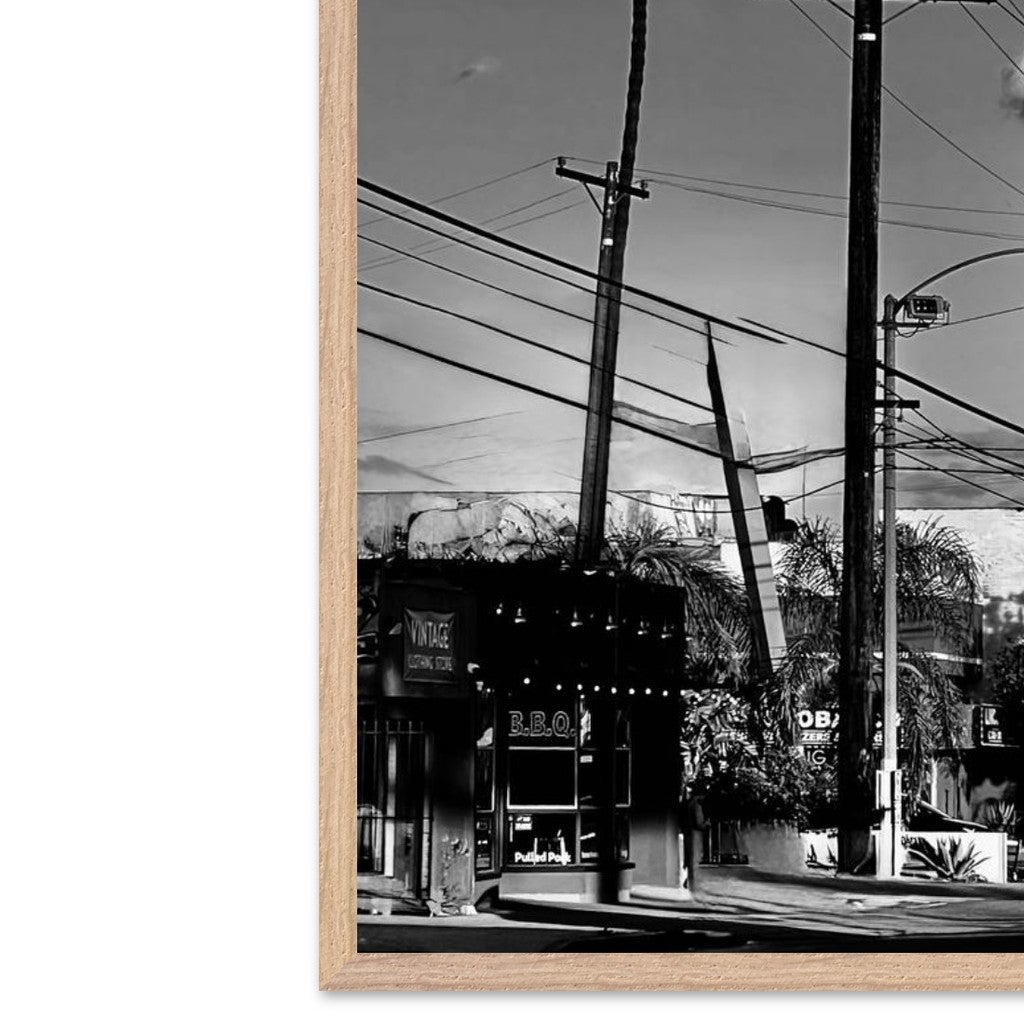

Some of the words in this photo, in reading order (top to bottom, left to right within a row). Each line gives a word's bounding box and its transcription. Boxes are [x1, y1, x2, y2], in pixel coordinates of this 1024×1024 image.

[411, 620, 449, 649] VINTAGE
[508, 710, 577, 738] B.B.Q.
[547, 851, 572, 863] Pok
